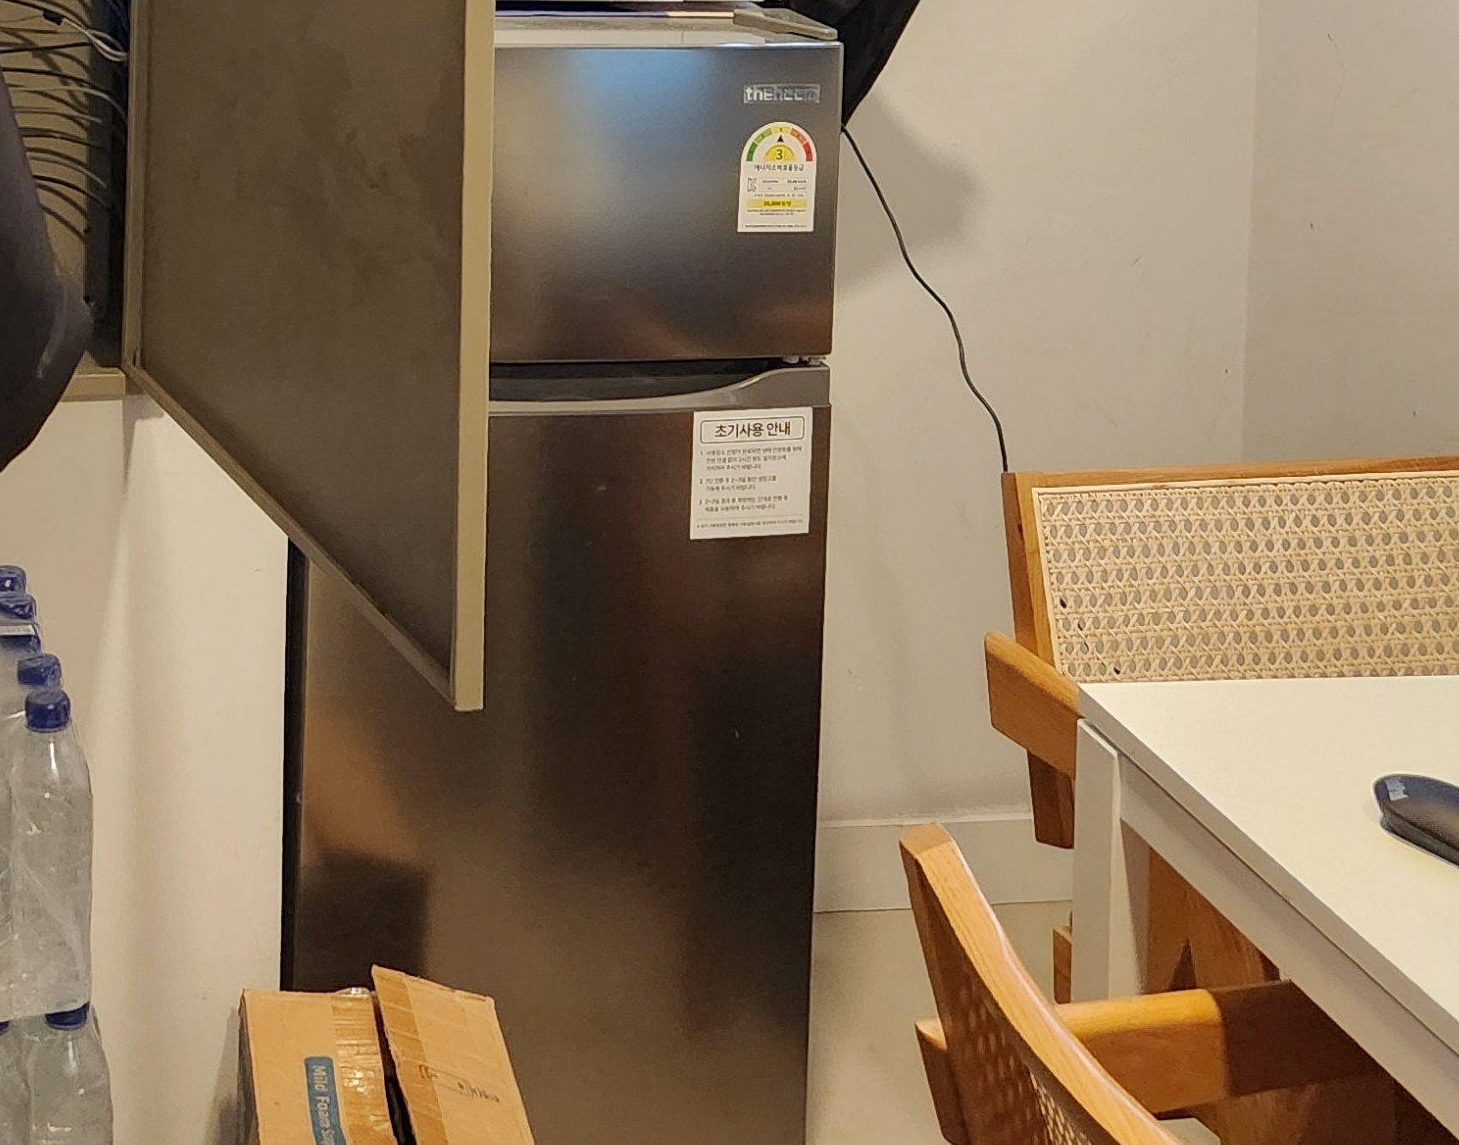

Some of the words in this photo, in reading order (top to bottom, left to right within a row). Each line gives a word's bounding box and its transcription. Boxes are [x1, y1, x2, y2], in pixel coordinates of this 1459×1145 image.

[775, 148, 783, 161] 3
[714, 422, 764, 439] 초기사용
[766, 420, 791, 437] 안내
[313, 1064, 329, 1092] Mild
